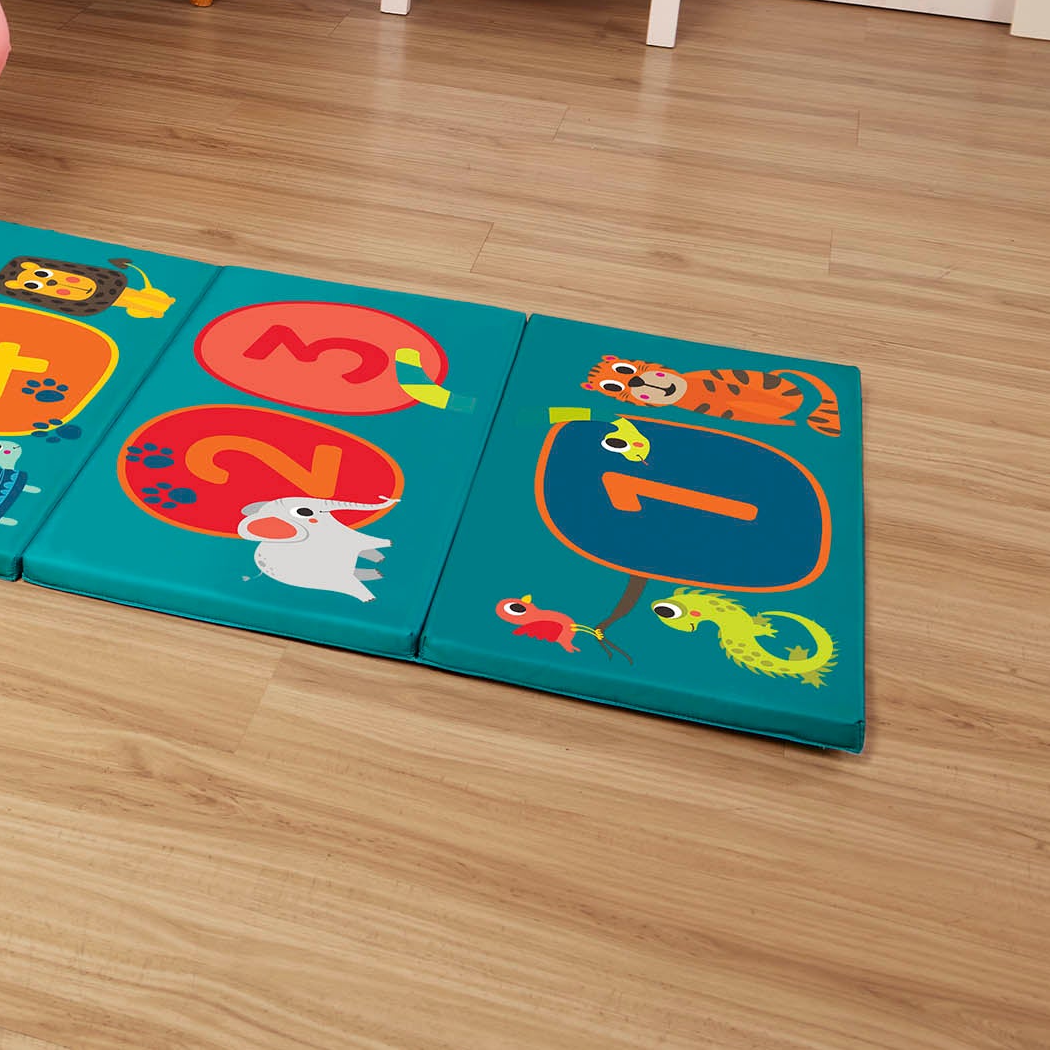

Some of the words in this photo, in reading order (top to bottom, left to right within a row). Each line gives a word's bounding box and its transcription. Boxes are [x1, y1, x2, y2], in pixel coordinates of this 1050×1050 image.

[242, 324, 389, 384] 3
[184, 434, 343, 499] 2
[602, 471, 759, 521] 1
